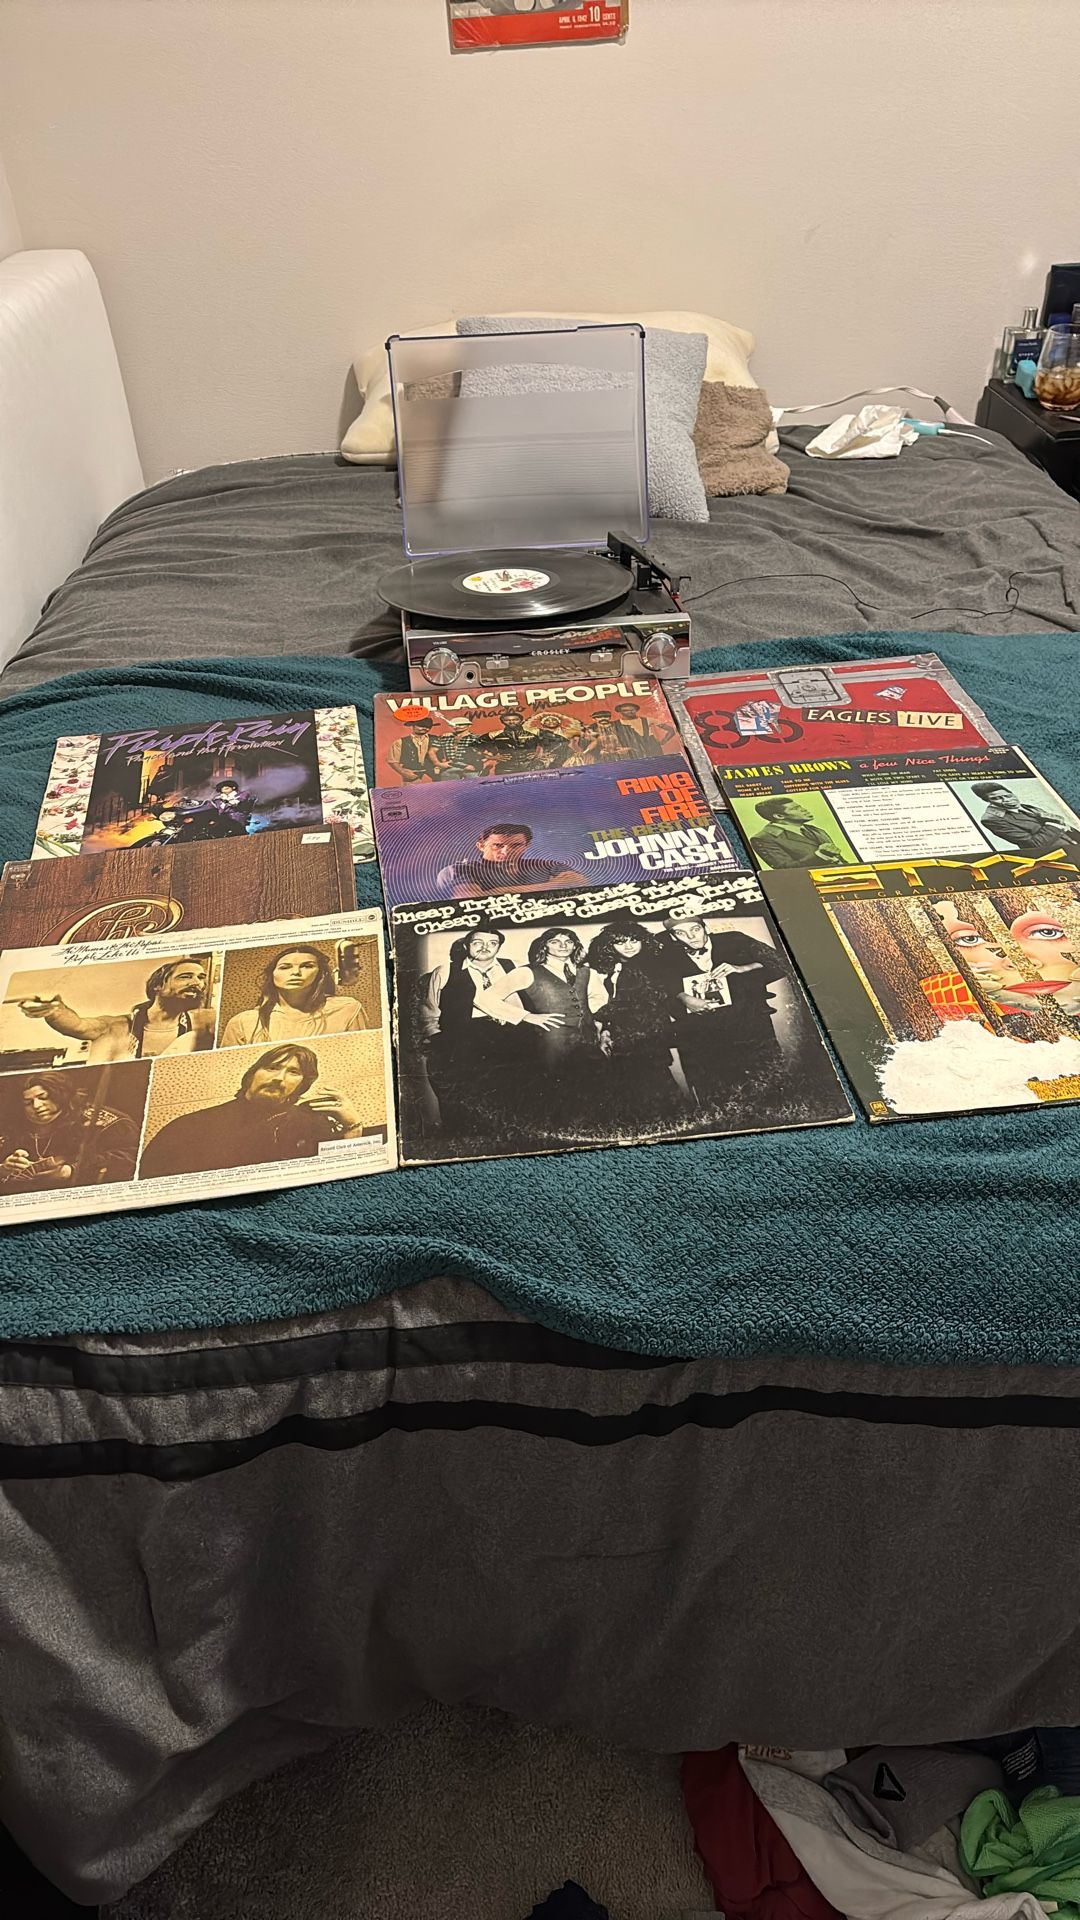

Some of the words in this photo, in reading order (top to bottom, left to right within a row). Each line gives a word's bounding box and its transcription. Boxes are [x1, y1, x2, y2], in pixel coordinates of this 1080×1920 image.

[589, 6, 600, 22] 10
[386, 690, 518, 713] VILLAGE
[526, 680, 654, 704] PEOPLE
[807, 710, 892, 724] EAGLES
[906, 714, 956, 726] LIVE
[104, 721, 229, 765] Purple
[228, 718, 312, 758] Rain
[168, 750, 193, 760] and
[197, 746, 216, 756] the
[218, 740, 285, 758] Revolution
[724, 765, 784, 780] JAMES
[788, 760, 852, 774] BROWN
[872, 760, 898, 770] few
[905, 757, 936, 766] Nice
[938, 754, 992, 765] Things
[616, 772, 694, 796] RING
[659, 786, 699, 805] OF
[640, 800, 710, 825] FIRE
[584, 825, 717, 860] JOHNNY
[588, 827, 628, 842] THE
[632, 820, 683, 837] BEST
[638, 841, 734, 870] CASH
[808, 848, 1080, 894] STYX
[510, 900, 577, 924] Cheap
[577, 882, 641, 904] Trick
[576, 895, 642, 918] Cheap
[641, 876, 706, 899] Trick
[630, 894, 698, 916] Cheap
[696, 876, 759, 900] Trick
[818, 894, 860, 902] THE
[878, 886, 955, 898] GRAND
[392, 905, 455, 924] Cheap
[459, 894, 523, 912] Trick
[414, 914, 480, 935] Cheap
[485, 900, 547, 920] Trick
[668, 898, 736, 920] Cheap
